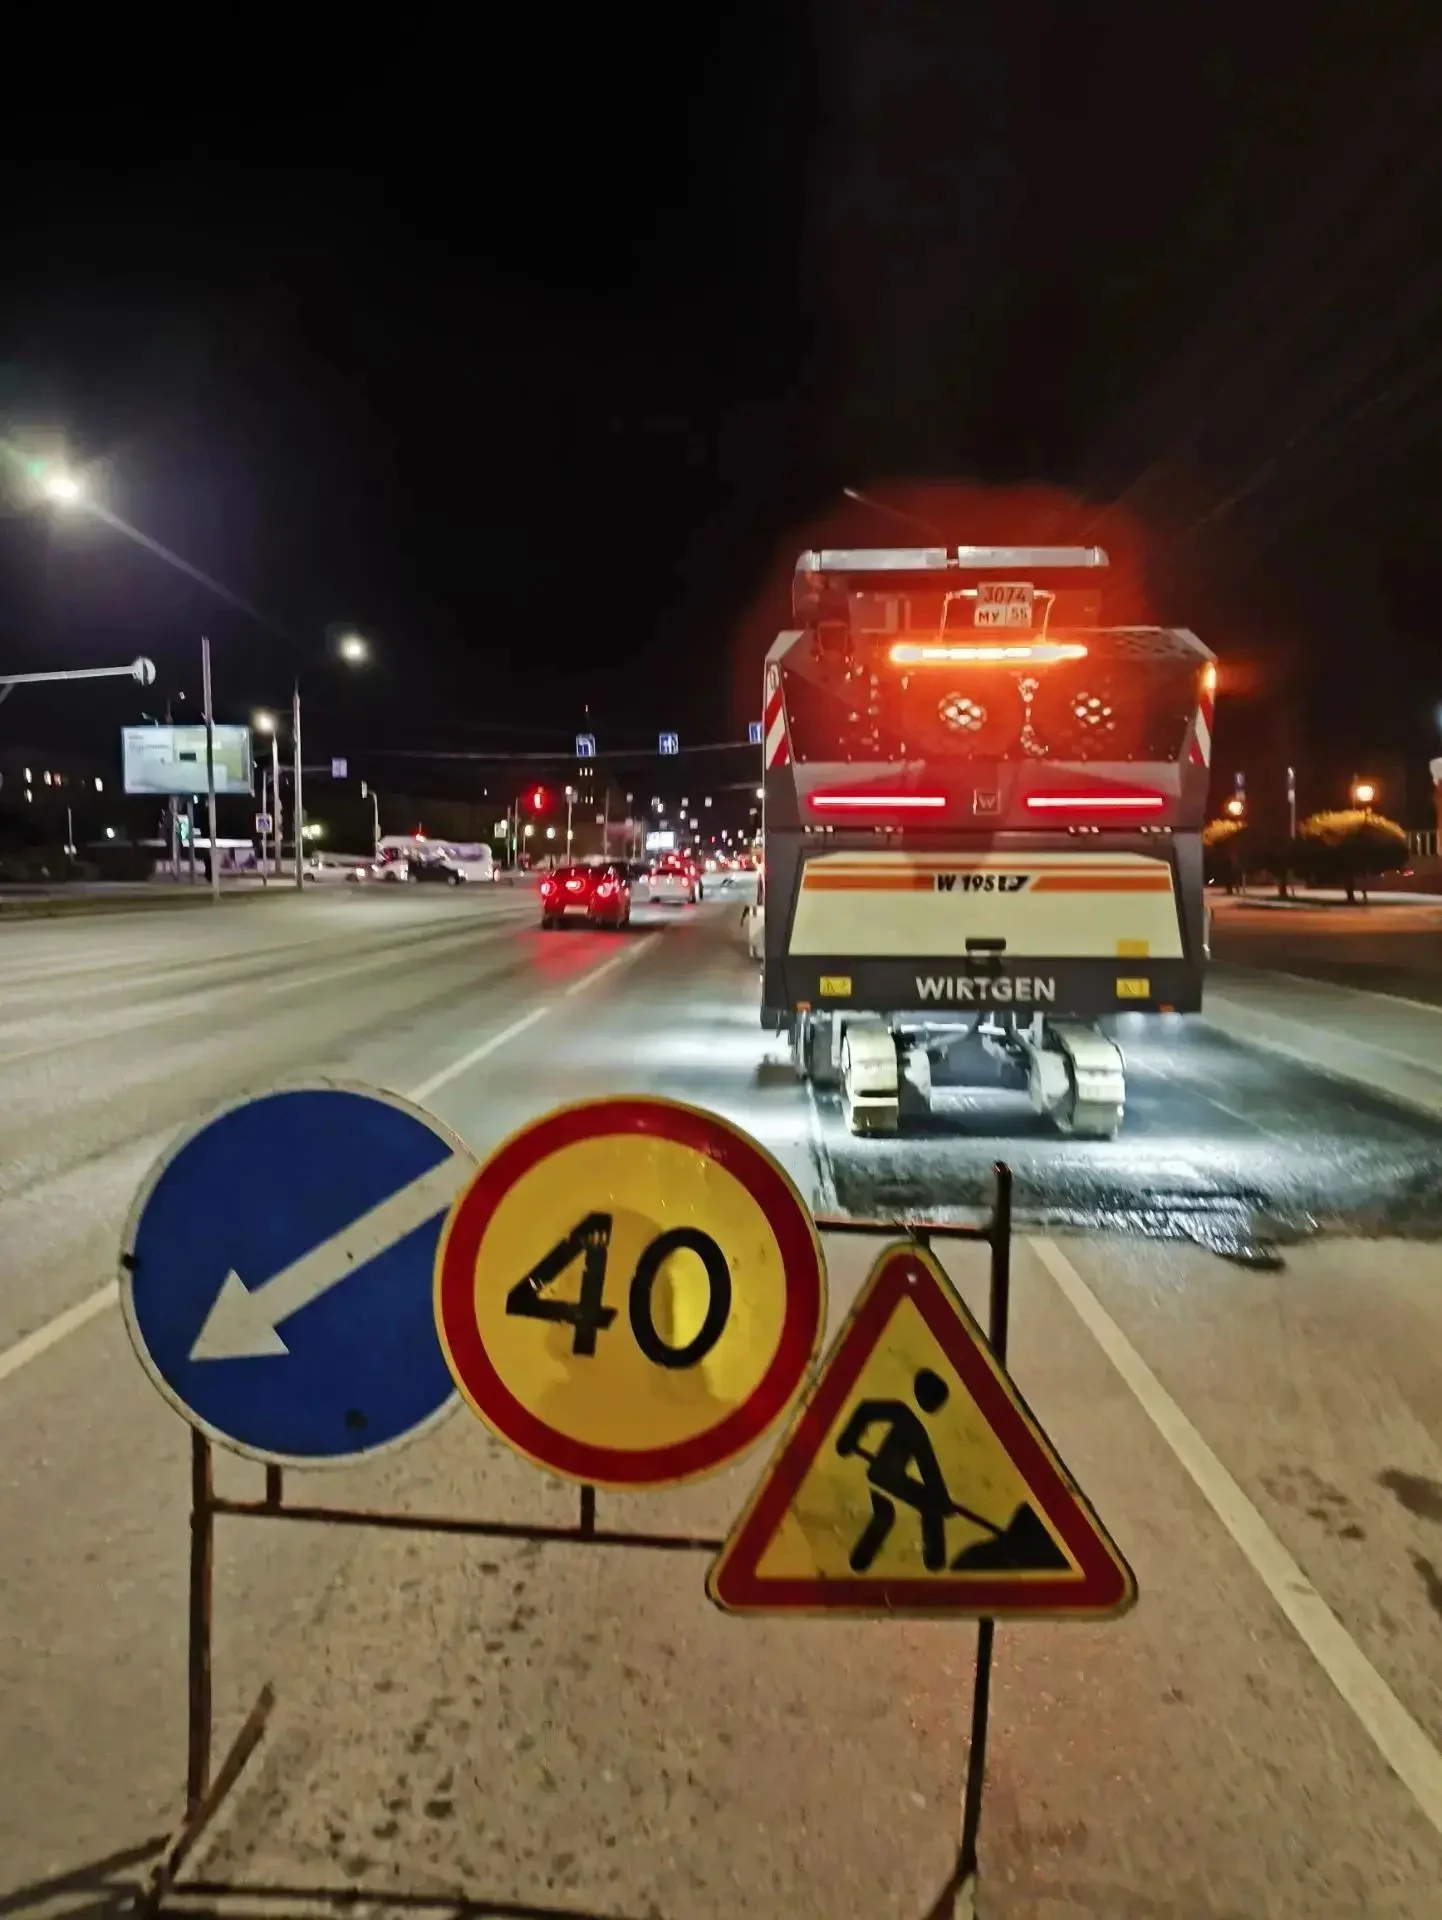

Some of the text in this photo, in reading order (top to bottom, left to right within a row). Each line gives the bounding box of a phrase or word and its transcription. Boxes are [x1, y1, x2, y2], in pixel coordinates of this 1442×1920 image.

[983, 586, 1027, 604] 3074
[937, 874, 956, 892] W
[915, 976, 1056, 1002] WIRTGEN
[505, 1211, 732, 1370] 40
